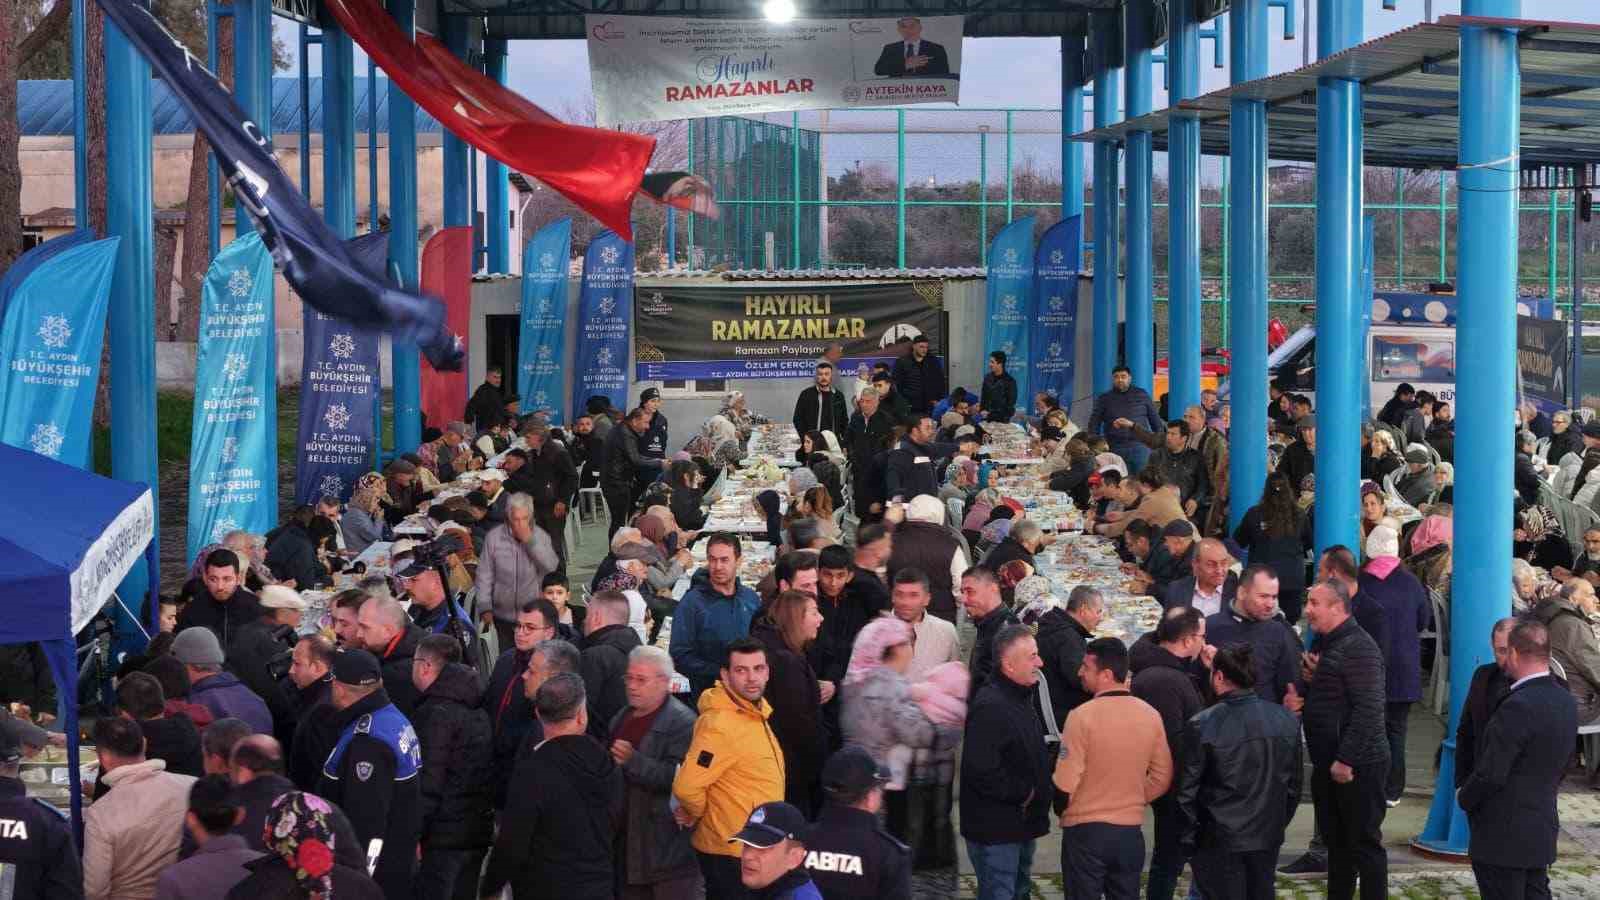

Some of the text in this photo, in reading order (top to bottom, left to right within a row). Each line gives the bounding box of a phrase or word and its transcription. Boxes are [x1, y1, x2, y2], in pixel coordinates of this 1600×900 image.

[696, 51, 776, 82] Hayırlı
[665, 79, 814, 102] RAMAZANLAR
[866, 84, 946, 95] AYTEKİN KAYA
[745, 294, 831, 316] HAYIRLI
[712, 318, 865, 341] RAMAZANLAR
[735, 346, 779, 355] Ramazan
[48, 352, 78, 362] AYDIN
[10, 359, 92, 376] BÜYÜKŞEHİR
[318, 362, 366, 373] T.C. AYDIN
[745, 360, 778, 369] ÖZLEM
[24, 375, 80, 387] BELEDİYESİ
[310, 370, 372, 384] BÜYÜKŞEHİR
[313, 383, 368, 395] BELEDİYESİ
[313, 433, 361, 443] T.C. AYDIN
[305, 441, 367, 455] BÜYÜKŞEHİR
[307, 454, 363, 465] BELEDİYESİ
[803, 850, 863, 875] ABITA
